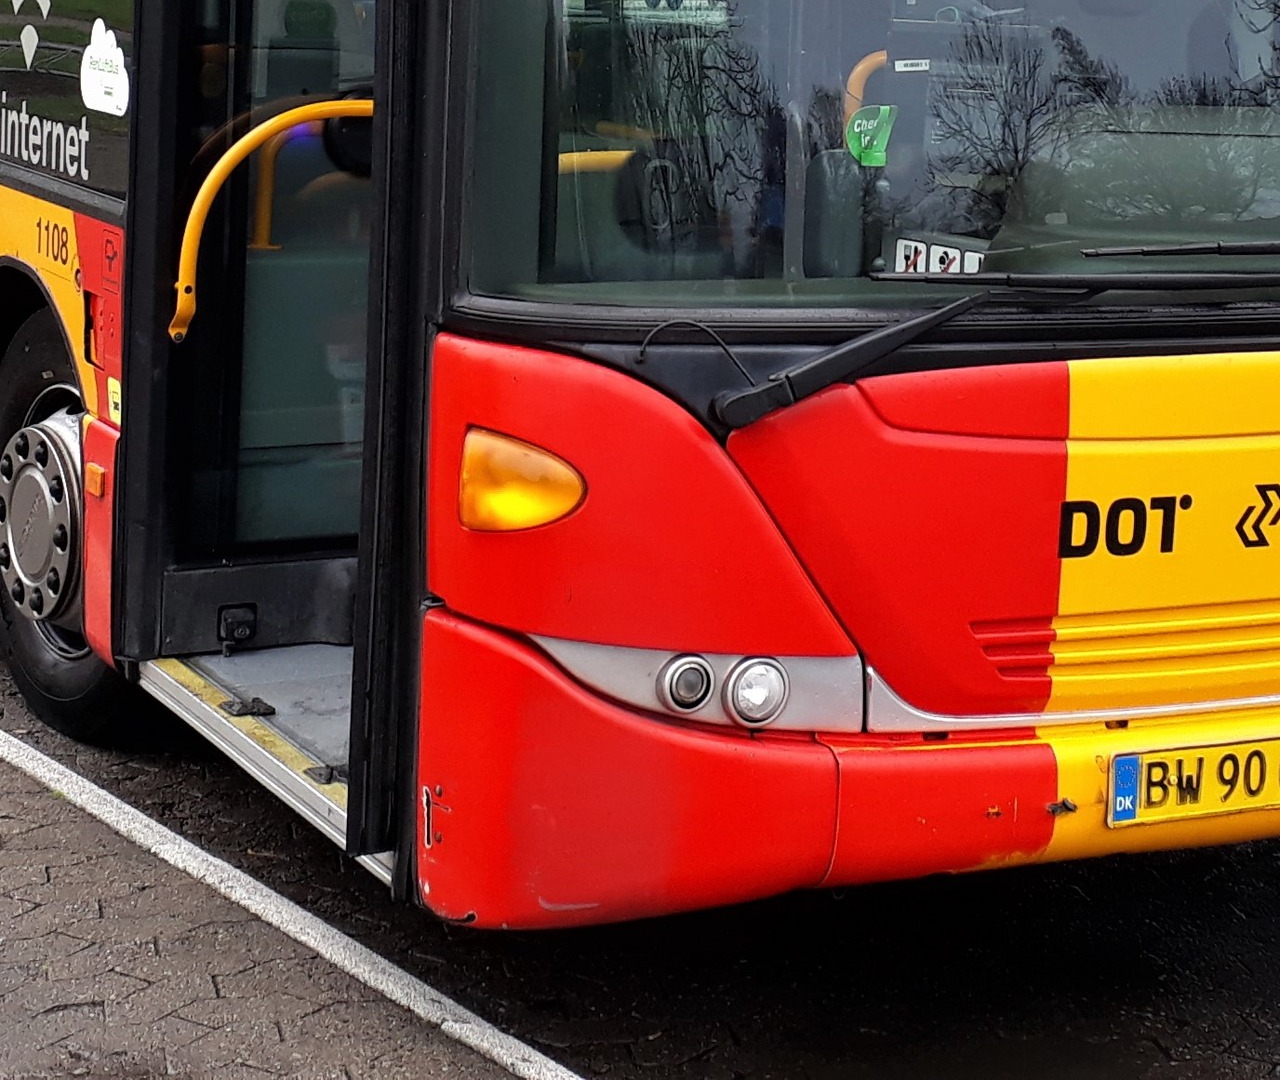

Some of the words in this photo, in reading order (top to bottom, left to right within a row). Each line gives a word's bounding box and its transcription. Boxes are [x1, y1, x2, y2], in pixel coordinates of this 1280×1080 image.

[0, 90, 90, 181] internet
[36, 216, 69, 266] 1108
[1057, 494, 1193, 559] DOT
[1115, 795, 1134, 812] DK
[1144, 757, 1205, 809] BW
[1217, 749, 1267, 802] 90
